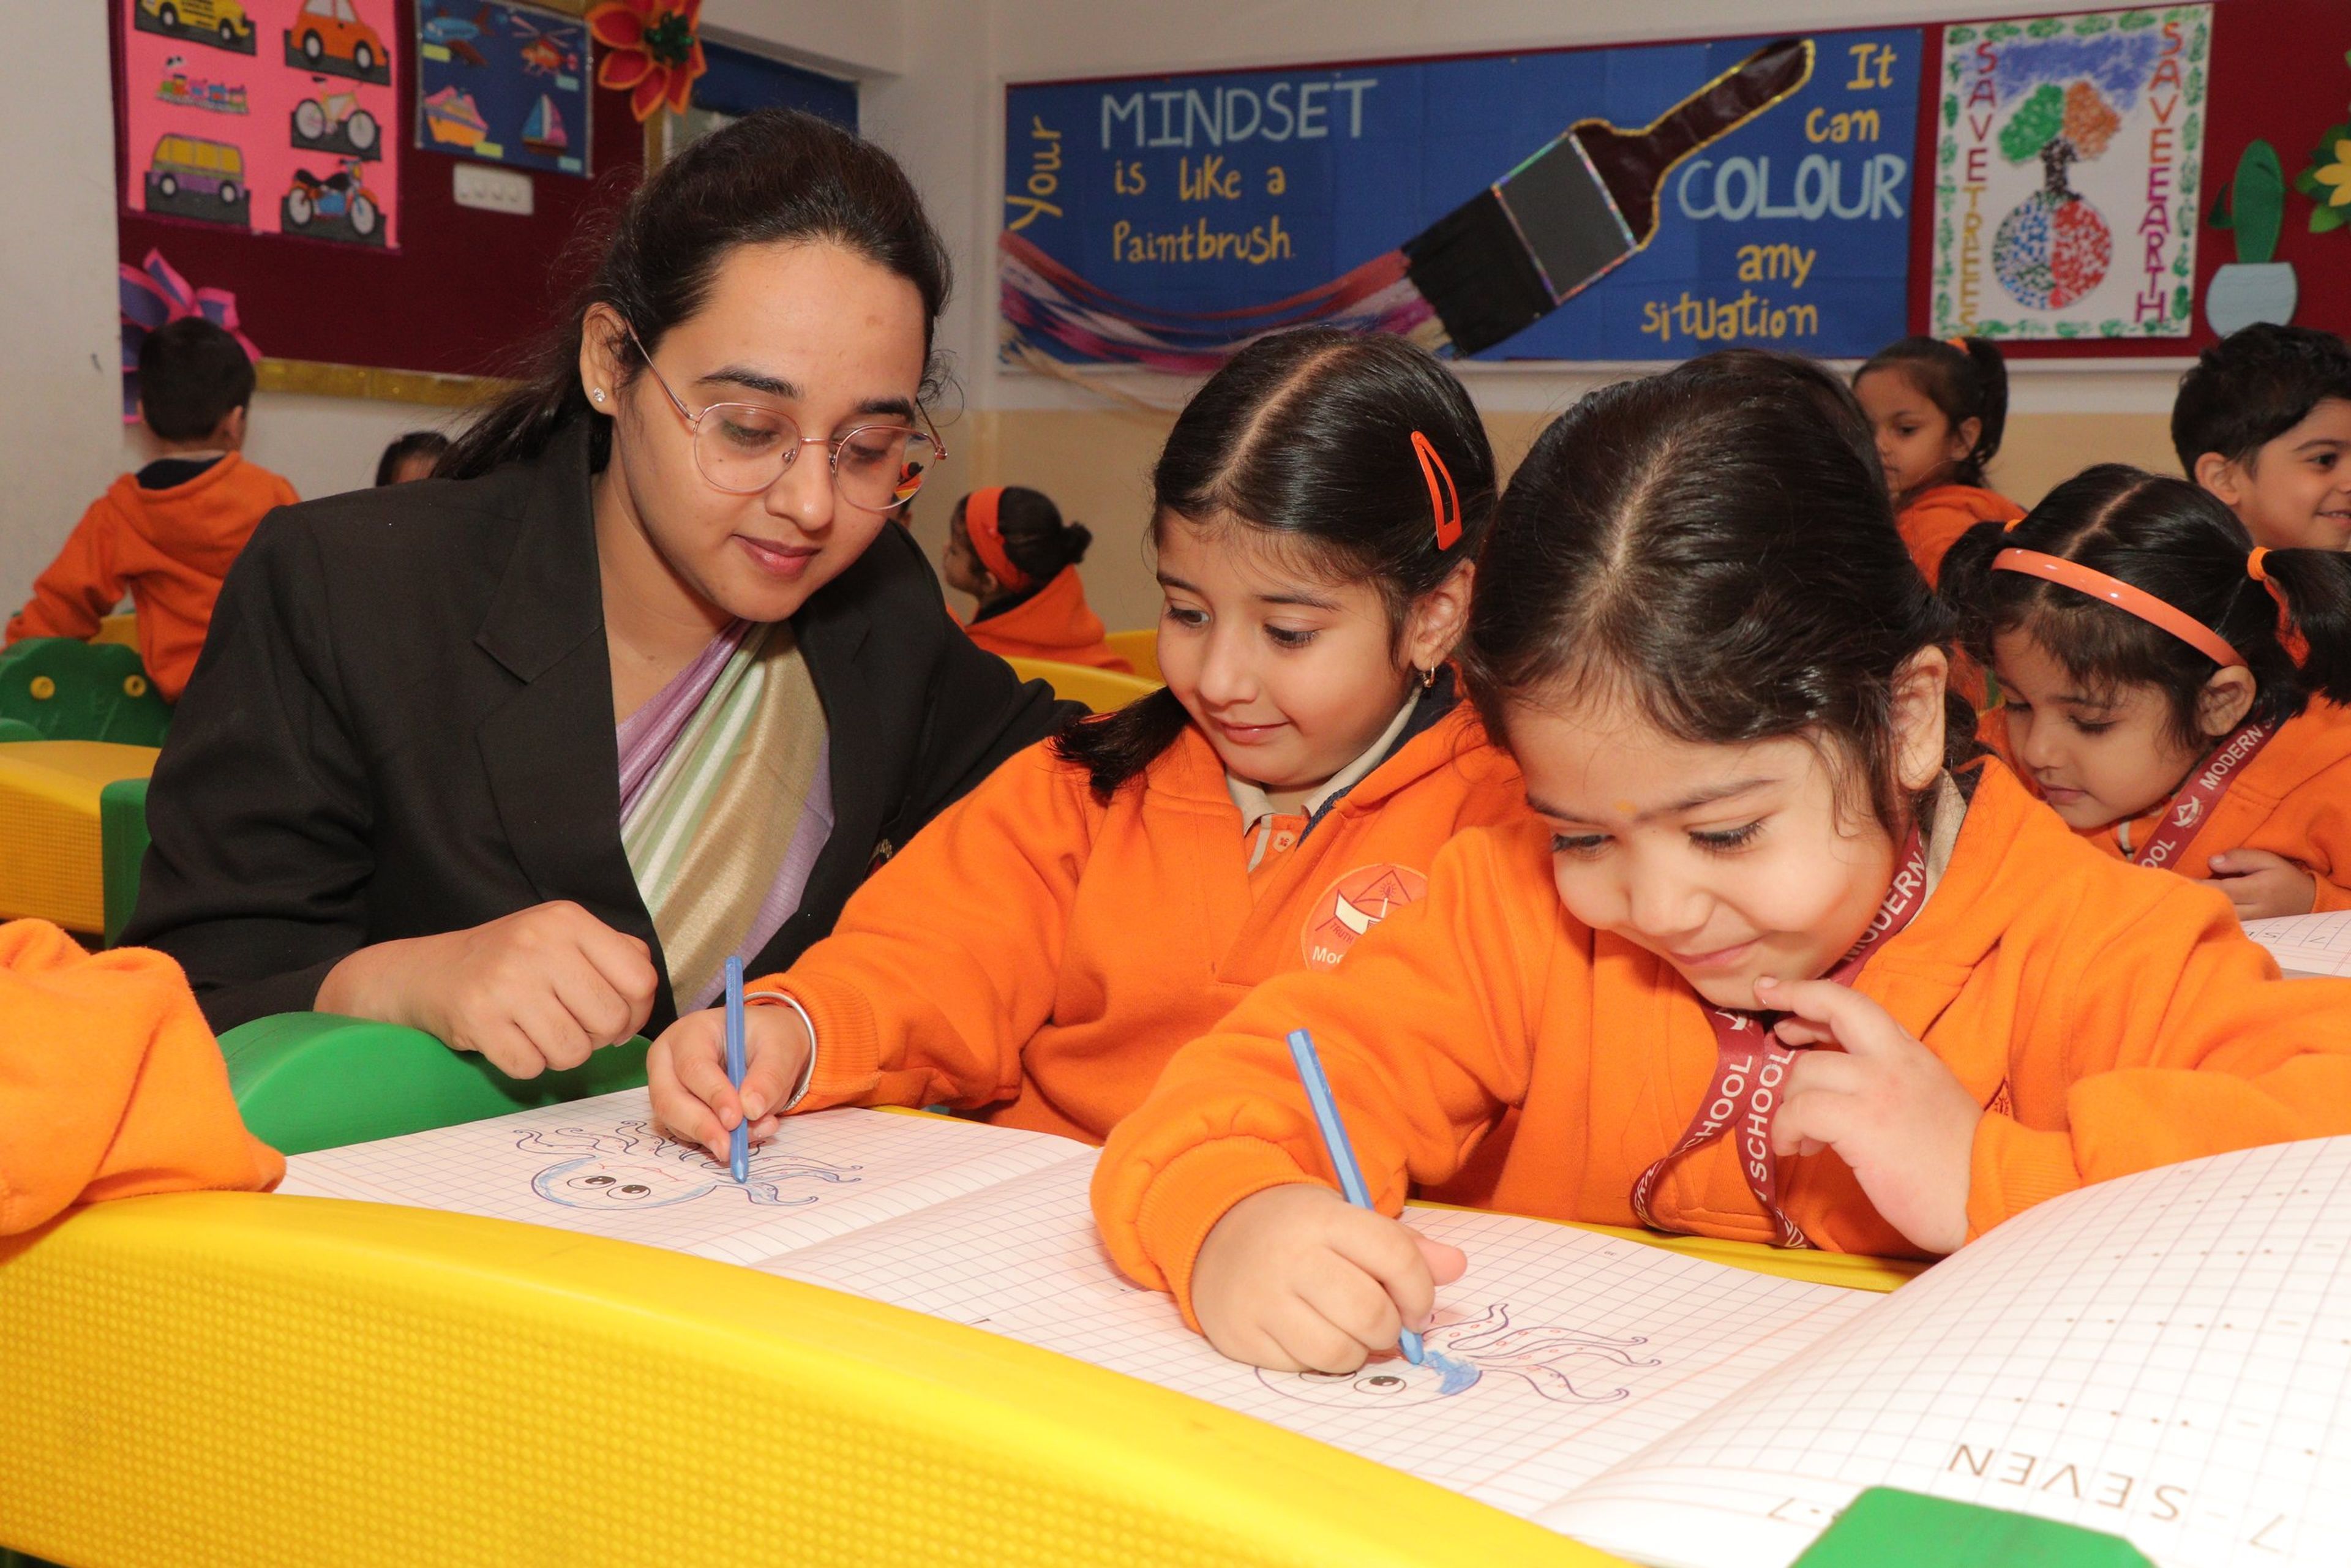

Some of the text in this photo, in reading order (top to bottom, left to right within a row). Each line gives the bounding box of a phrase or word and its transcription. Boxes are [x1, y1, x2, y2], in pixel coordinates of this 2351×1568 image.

[1846, 43, 1896, 89] It
[1101, 78, 1378, 149] MINDSET
[1005, 114, 1063, 231] Your
[1114, 159, 1147, 195] is
[1265, 165, 1287, 195] a
[1678, 154, 1907, 220] COLOUR
[1960, 41, 1997, 336] SAVE TREES
[2135, 22, 2183, 323] SAVE EARTH
[1112, 215, 1292, 265] Paintbrush
[1736, 243, 1817, 288] any
[2200, 724, 2263, 791] MODERN
[1329, 921, 1354, 945] TRUTH
[1747, 1050, 1796, 1182] SCHOOL
[1948, 1442, 2189, 1523] SEVEN
